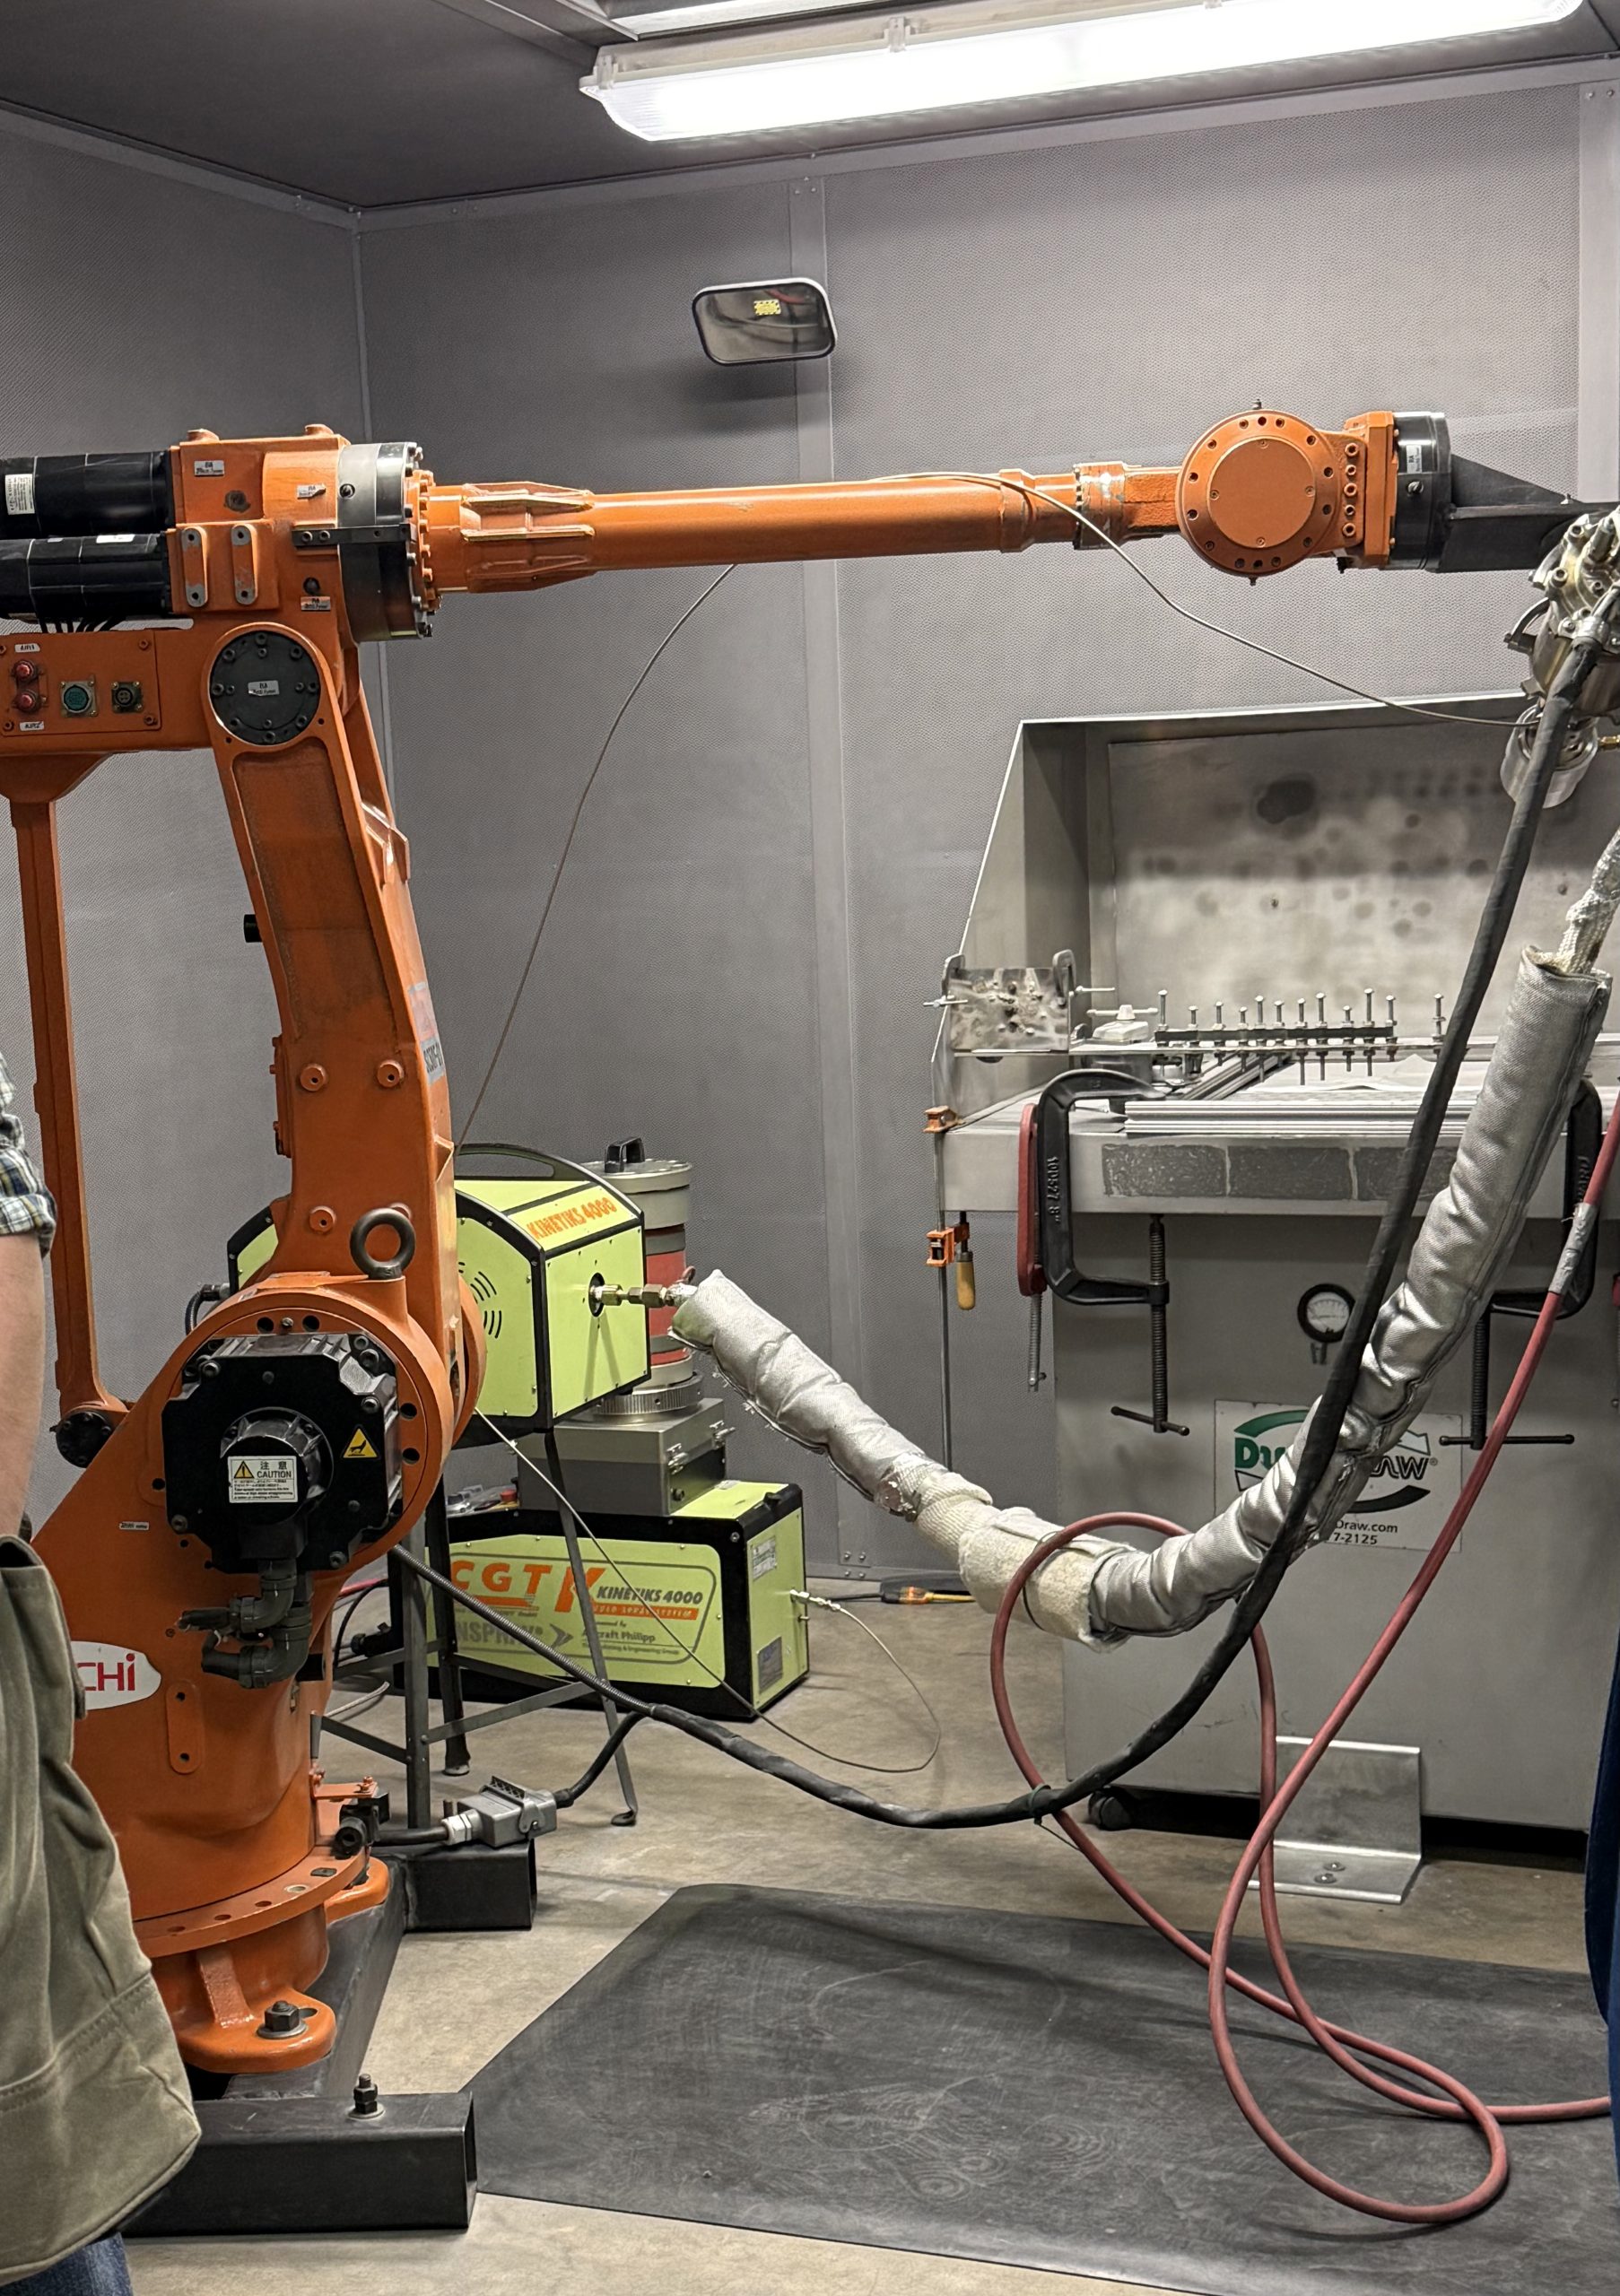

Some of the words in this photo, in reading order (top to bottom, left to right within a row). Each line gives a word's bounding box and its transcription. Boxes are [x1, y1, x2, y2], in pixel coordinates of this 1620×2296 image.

[527, 1206, 588, 1239] KINETIKS
[580, 1196, 617, 1220] 4000
[257, 1471, 292, 1479] CAUTION
[451, 1561, 553, 1595] CGT
[597, 1586, 663, 1603] KINETIKS
[662, 1590, 703, 1605] 4000
